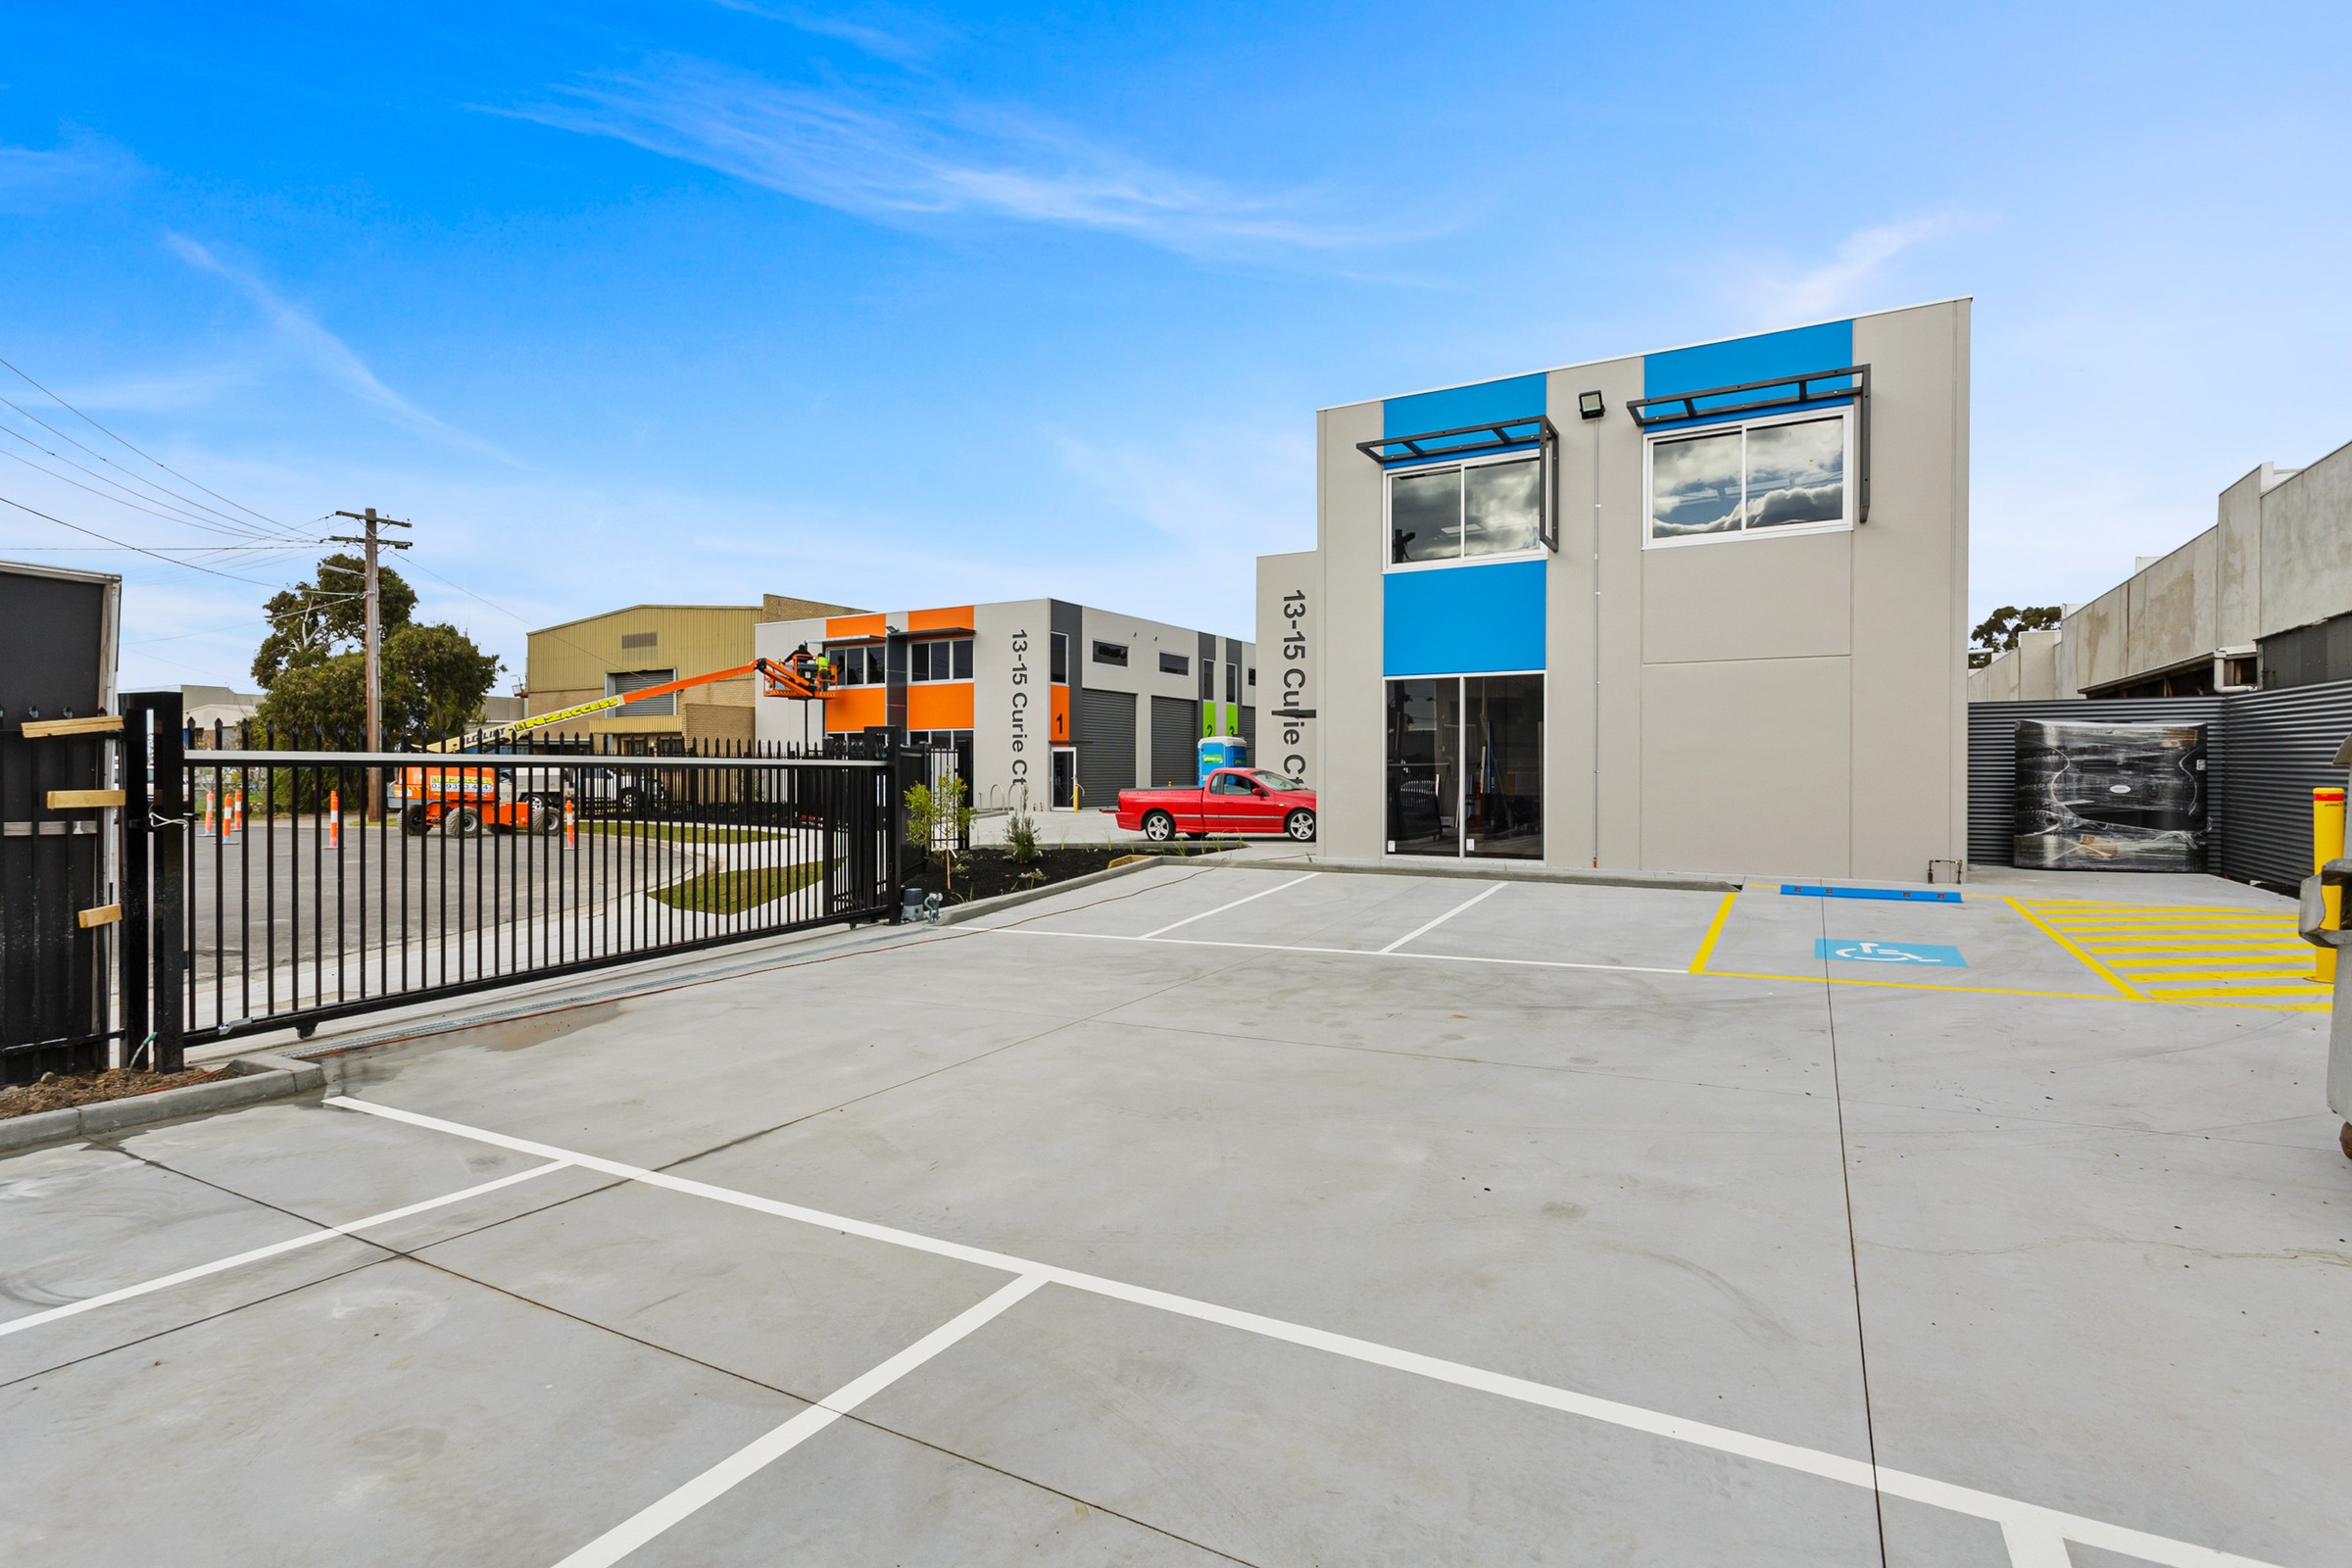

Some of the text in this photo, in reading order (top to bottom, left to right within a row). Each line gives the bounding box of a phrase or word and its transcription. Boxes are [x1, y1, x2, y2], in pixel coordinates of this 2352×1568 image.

[1283, 589, 1306, 661] 13-15
[1011, 629, 1028, 785] 13-15 Curie Ct
[1055, 712, 1063, 734] 1
